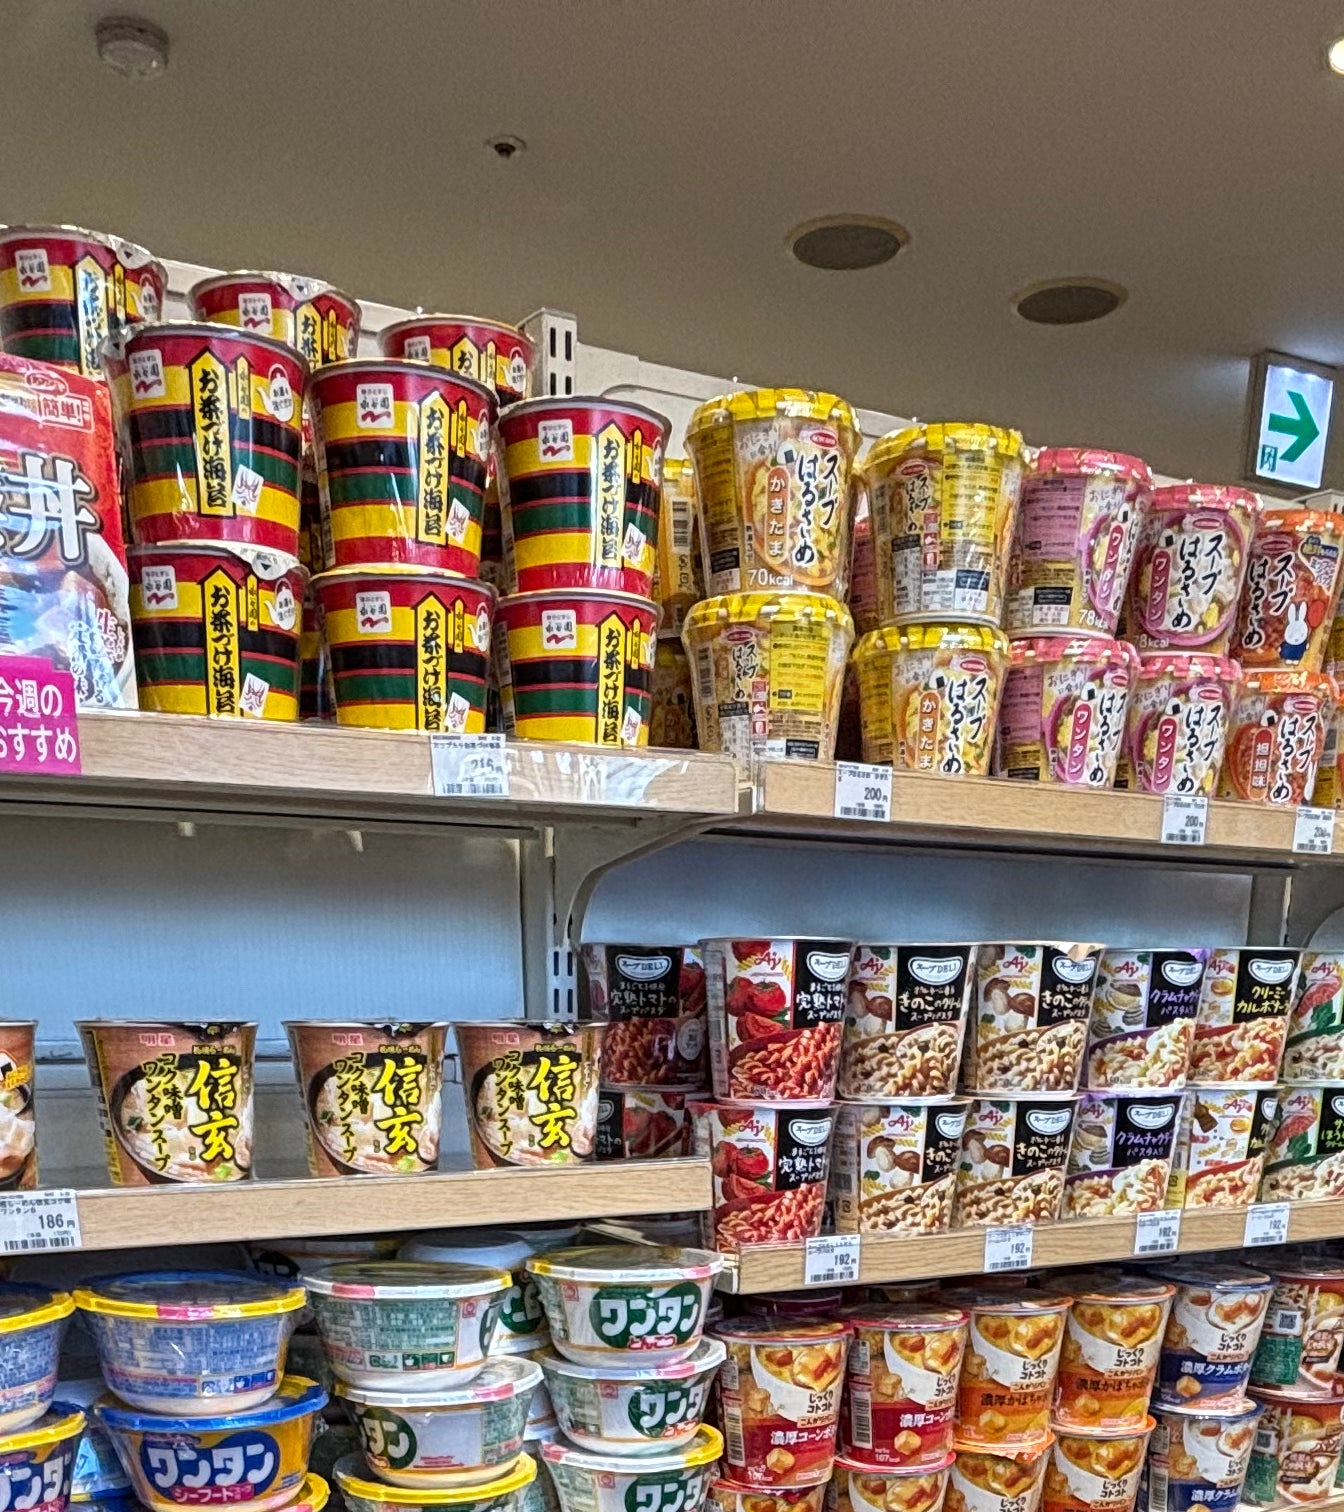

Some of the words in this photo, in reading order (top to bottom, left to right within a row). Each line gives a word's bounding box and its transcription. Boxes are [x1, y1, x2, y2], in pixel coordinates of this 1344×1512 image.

[199, 368, 226, 508] お茶づけ海苔
[424, 408, 446, 537] お茶づけ海苔
[600, 440, 621, 562] お茶づけ海苔
[770, 478, 785, 556] かきたま
[795, 454, 818, 564] はるさめ
[822, 455, 838, 526] スープ
[747, 569, 793, 584] 70kcal
[1152, 558, 1167, 622] ワンタン
[1172, 538, 1198, 629] はるさめ
[1202, 532, 1222, 596] スープ
[1246, 559, 1266, 646] はるさめ
[1275, 558, 1294, 613] スープ
[210, 583, 235, 715] お茶づけ海苔
[423, 610, 444, 731] お茶づけ海苔
[602, 628, 622, 745] お茶づけ海苔
[921, 698, 934, 769] かきたま
[944, 681, 964, 773] はるさめ
[970, 678, 987, 740] スープ
[1070, 708, 1090, 778] ワンタン
[1089, 690, 1113, 785] はるさめ
[1155, 717, 1174, 786] ワンタン
[1178, 705, 1201, 794] はるさめ
[1202, 704, 1220, 760] スープ
[1298, 713, 1315, 769] スープ
[1254, 742, 1271, 786] 担担味
[1271, 715, 1295, 801] はるさめ
[142, 1062, 170, 1171] ワンタンスープ
[189, 1058, 242, 1161] 信玄
[335, 1061, 357, 1162] ワンタンスープ
[373, 1058, 424, 1152] 信玄
[493, 1058, 513, 1155] ワンタンスープ
[530, 1056, 578, 1146] 信玄
[599, 1293, 699, 1338] ワンタン
[145, 1449, 274, 1489] ワンタン
